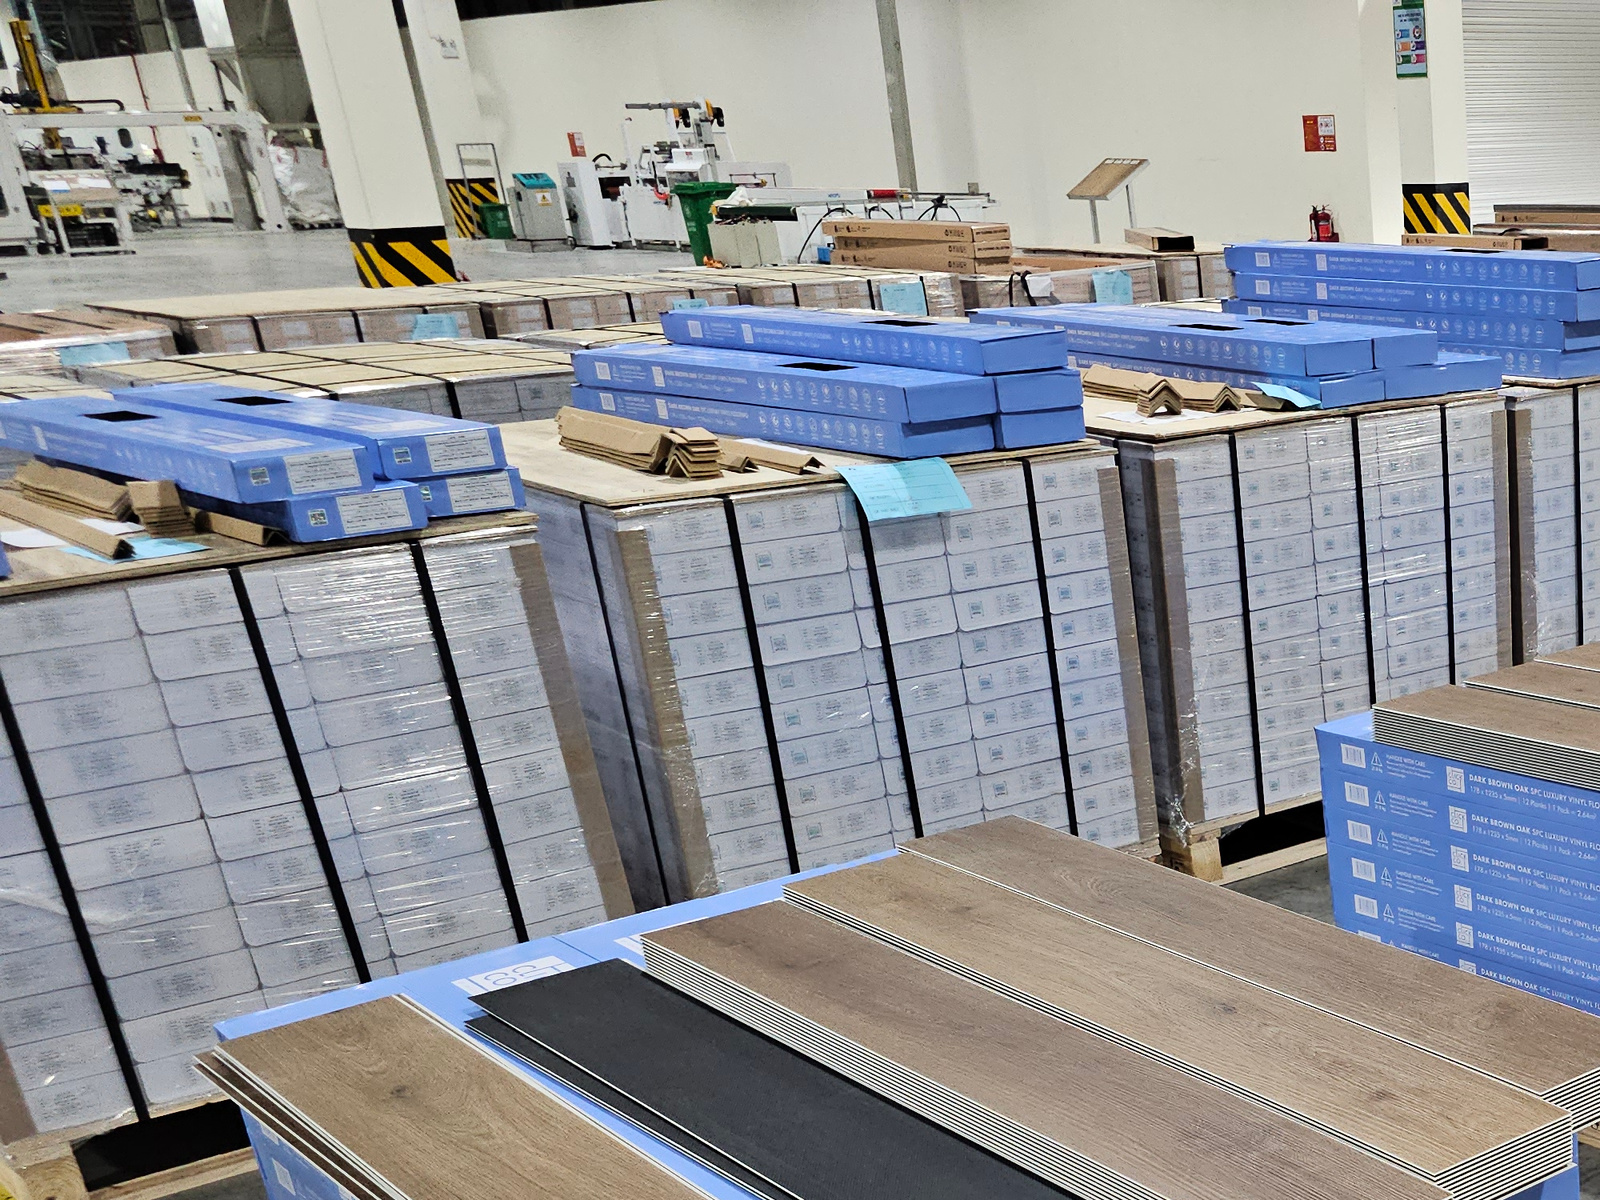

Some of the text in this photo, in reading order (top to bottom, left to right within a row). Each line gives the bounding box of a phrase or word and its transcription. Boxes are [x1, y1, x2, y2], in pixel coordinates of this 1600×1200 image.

[1469, 774, 1486, 784] DARK
[1488, 778, 1513, 790] BROWN
[1514, 784, 1529, 793] OAK
[1543, 790, 1567, 801] LUXURY
[1568, 796, 1587, 806] VINYL
[1471, 814, 1488, 824] DARK
[1490, 818, 1515, 830] BROWN
[1516, 825, 1530, 834] OAK
[1544, 831, 1568, 842] LUXURY
[1569, 837, 1588, 848] VINYL
